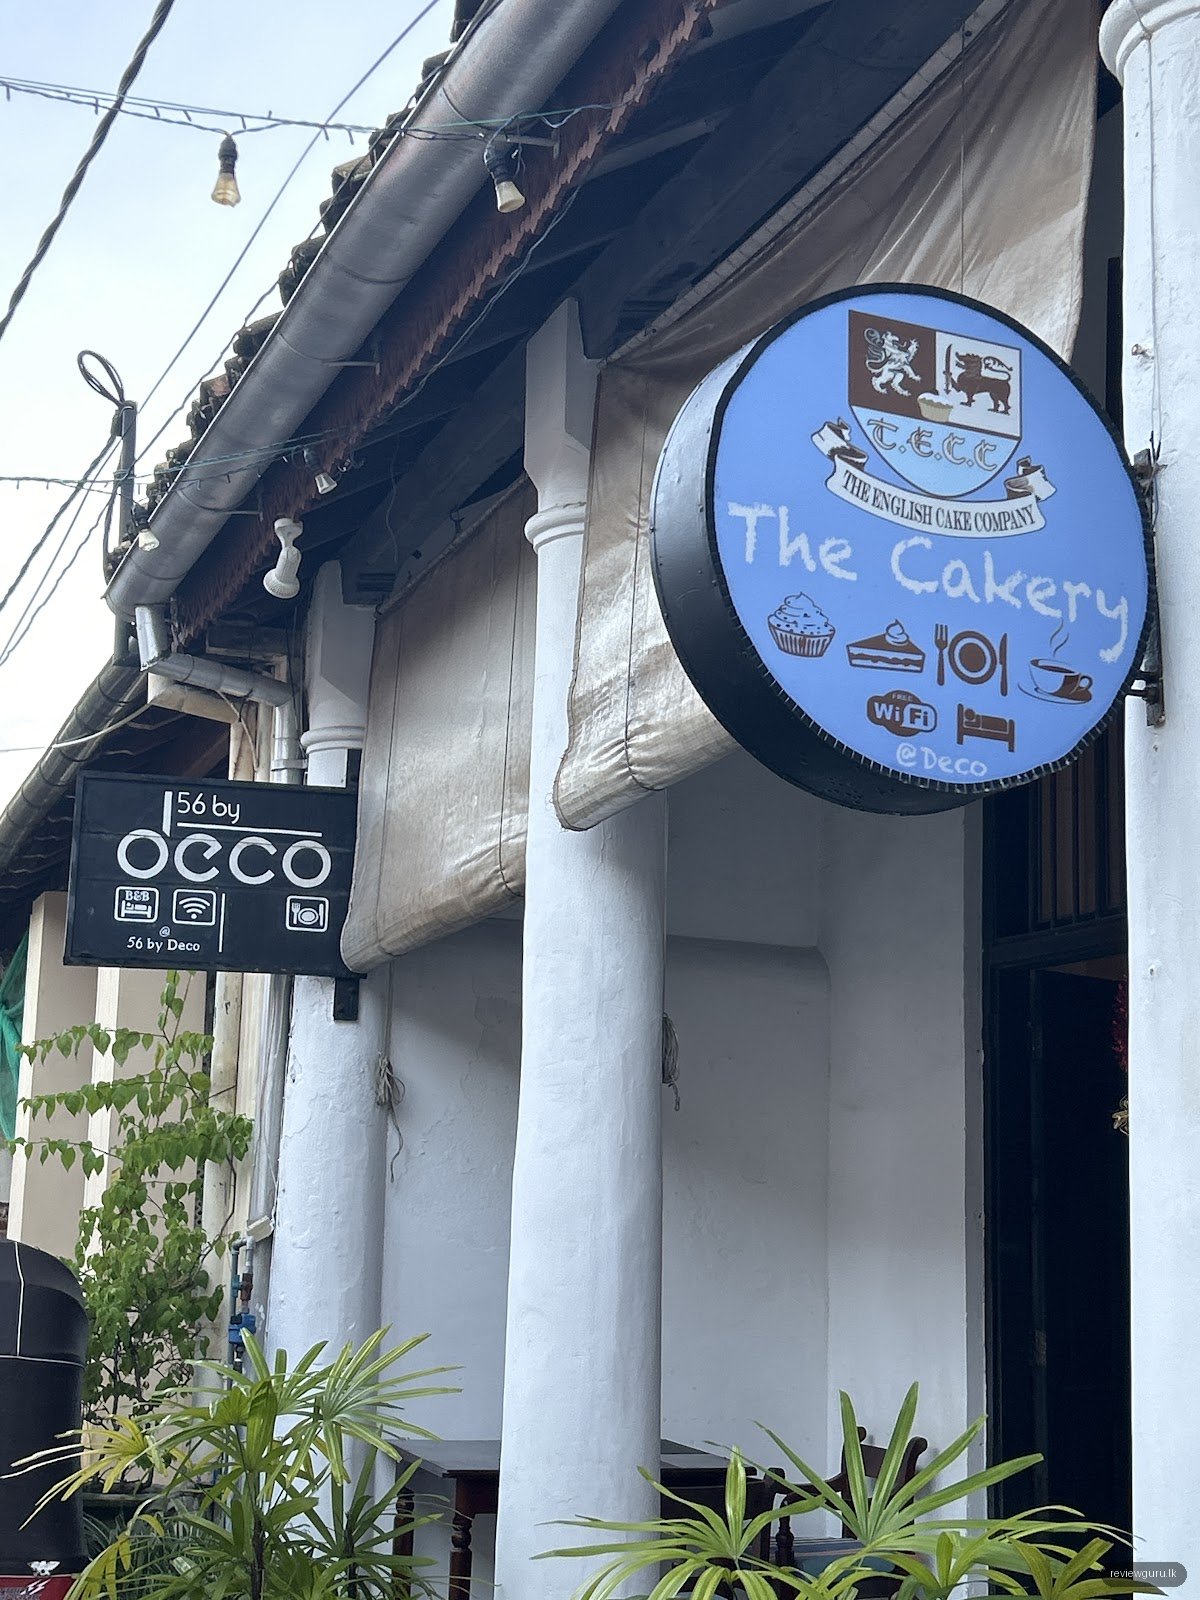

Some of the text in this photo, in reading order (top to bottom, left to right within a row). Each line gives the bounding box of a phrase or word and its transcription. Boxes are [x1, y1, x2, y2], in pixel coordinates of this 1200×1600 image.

[843, 470, 1036, 533] THE ENGLISH CAKE COMPANY
[728, 502, 1129, 663] The Cakery
[896, 742, 988, 777] @Deco
[177, 792, 240, 824] 56 by
[116, 791, 332, 888] deco
[125, 890, 150, 902] B&B
[126, 936, 201, 953] 56 by Deco
[159, 926, 170, 937] @
